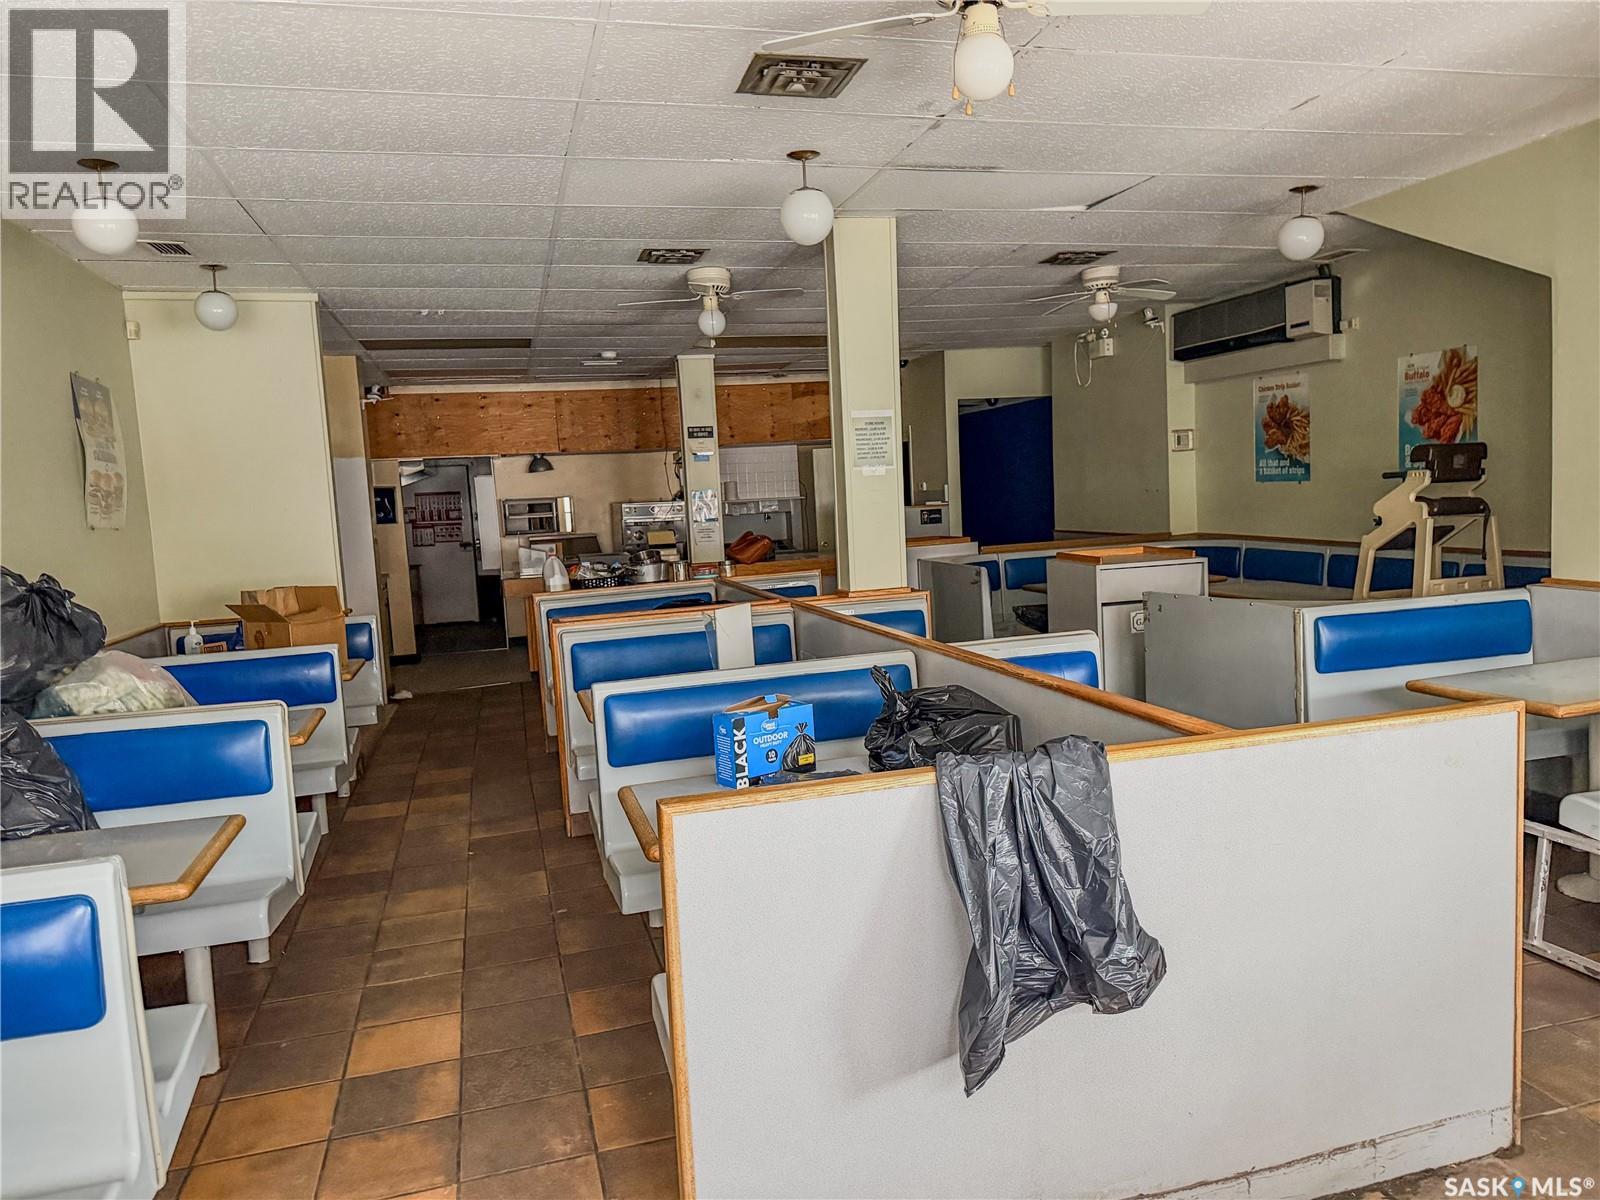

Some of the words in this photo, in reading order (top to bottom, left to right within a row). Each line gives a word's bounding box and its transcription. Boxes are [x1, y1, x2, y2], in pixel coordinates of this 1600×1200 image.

[1404, 368, 1430, 381] Buffalo
[1268, 458, 1279, 467] that
[1280, 457, 1290, 466] and
[1282, 466, 1289, 475] of
[1289, 465, 1305, 476] strips
[753, 731, 788, 744] OUTDOOR
[733, 727, 749, 790] BLACK
